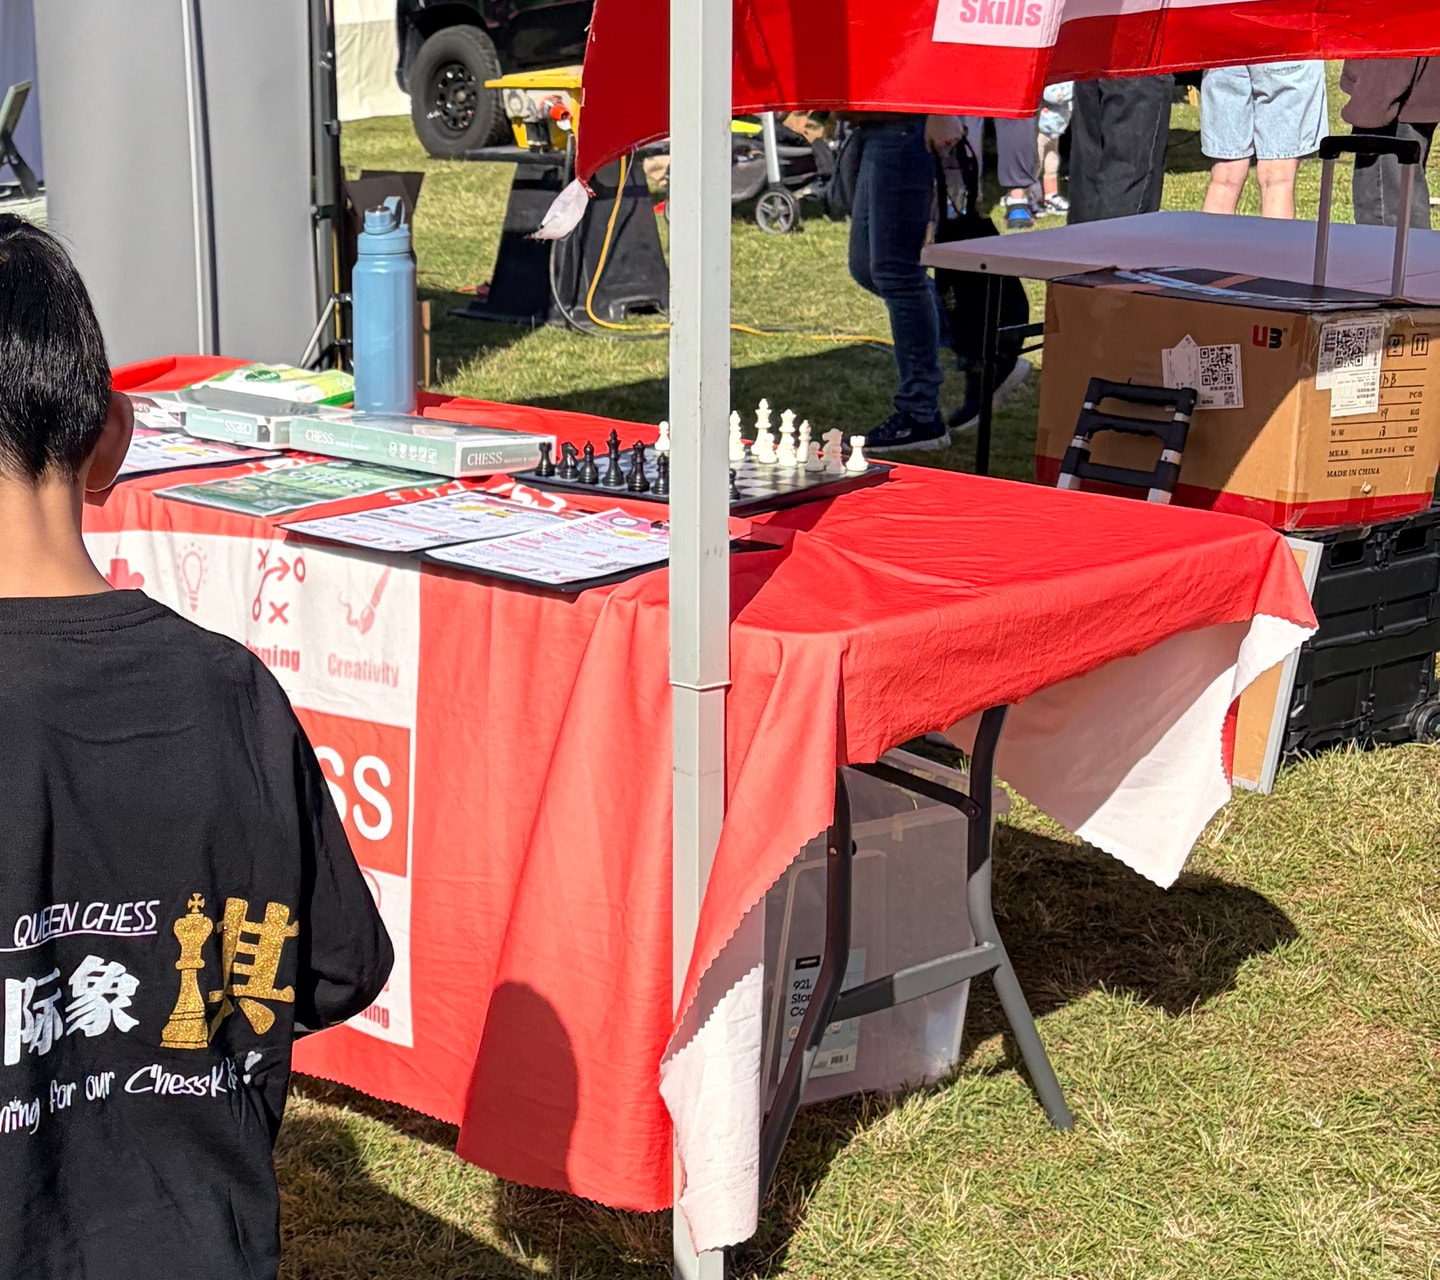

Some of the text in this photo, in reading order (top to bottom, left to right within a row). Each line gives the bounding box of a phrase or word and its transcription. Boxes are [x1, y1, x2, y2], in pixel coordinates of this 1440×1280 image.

[305, 428, 335, 445] CHESS
[467, 450, 503, 467] CHESS
[1327, 467, 1380, 478] MADE IN CHINA
[326, 652, 400, 689] Creativity
[13, 901, 80, 948] QUEEN
[81, 899, 160, 933] CHESS
[49, 1078, 77, 1114] for
[85, 1069, 116, 1101] our
